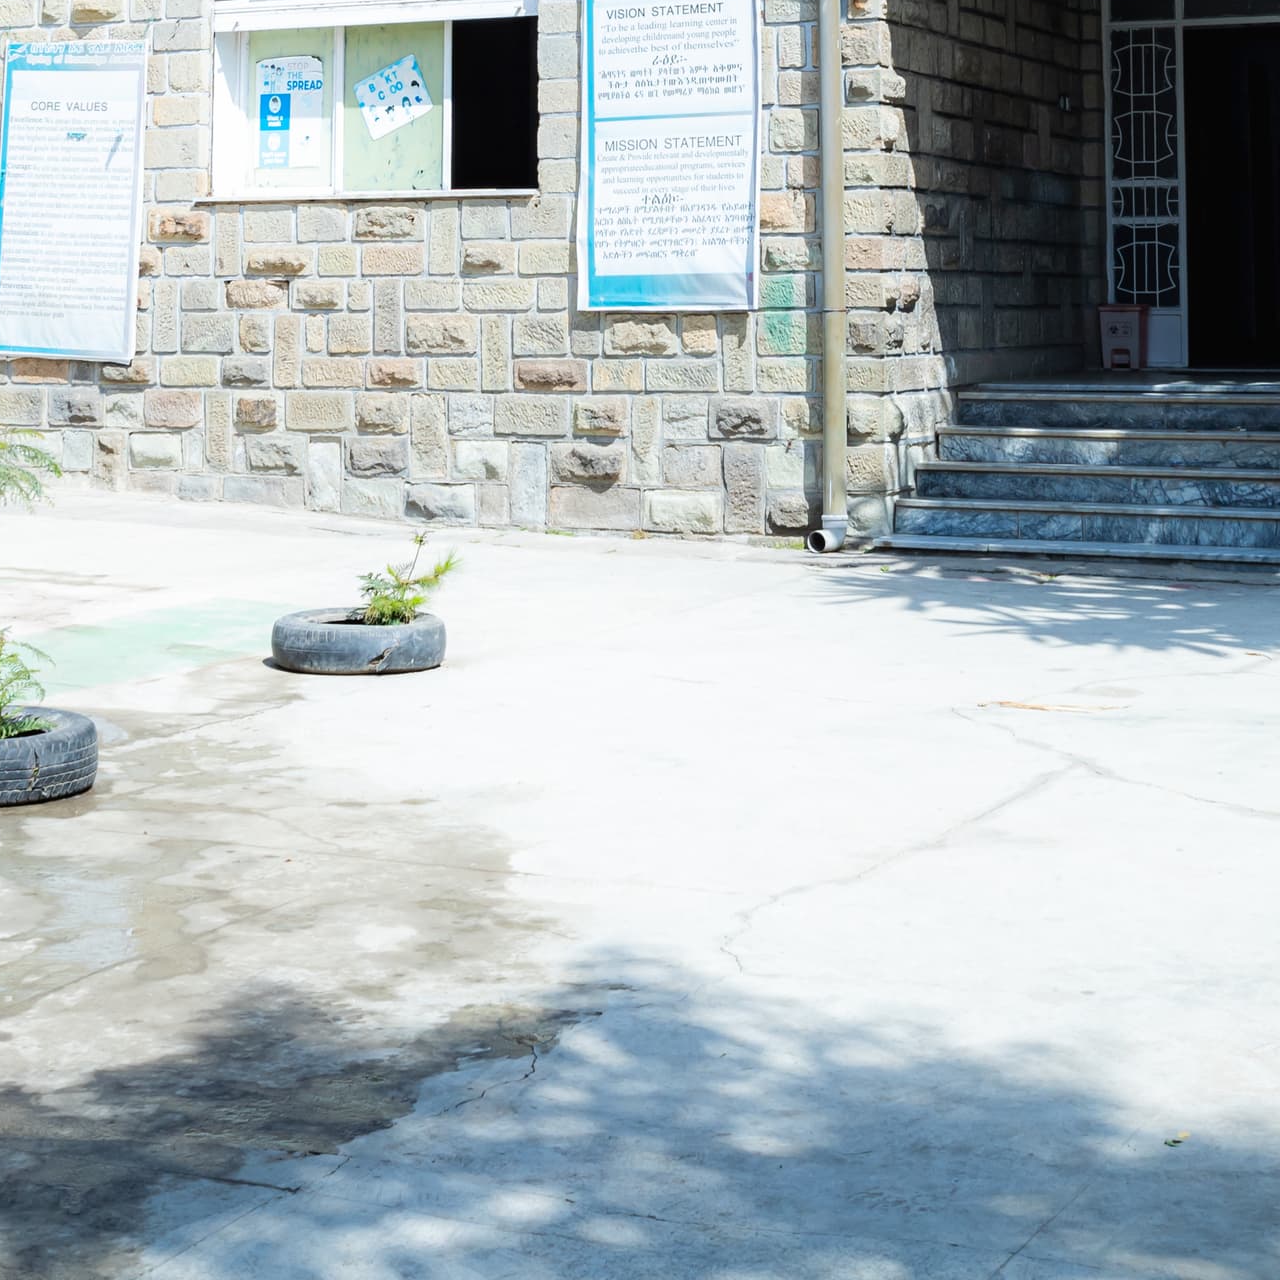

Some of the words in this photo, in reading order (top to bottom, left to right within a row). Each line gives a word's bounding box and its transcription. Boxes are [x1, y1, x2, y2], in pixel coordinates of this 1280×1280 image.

[606, 7, 646, 20] VISION
[651, 2, 724, 17] STATEMENT
[637, 21, 667, 32] leading
[669, 20, 703, 30] learning
[601, 34, 641, 45] developing
[711, 27, 737, 37] people
[650, 42, 669, 52] best
[671, 41, 681, 50] of
[287, 80, 323, 91] SPREAD
[31, 101, 61, 111] CORE
[66, 101, 108, 112] VALUES
[605, 138, 658, 152] MISSION
[664, 135, 742, 149] STATEMENT
